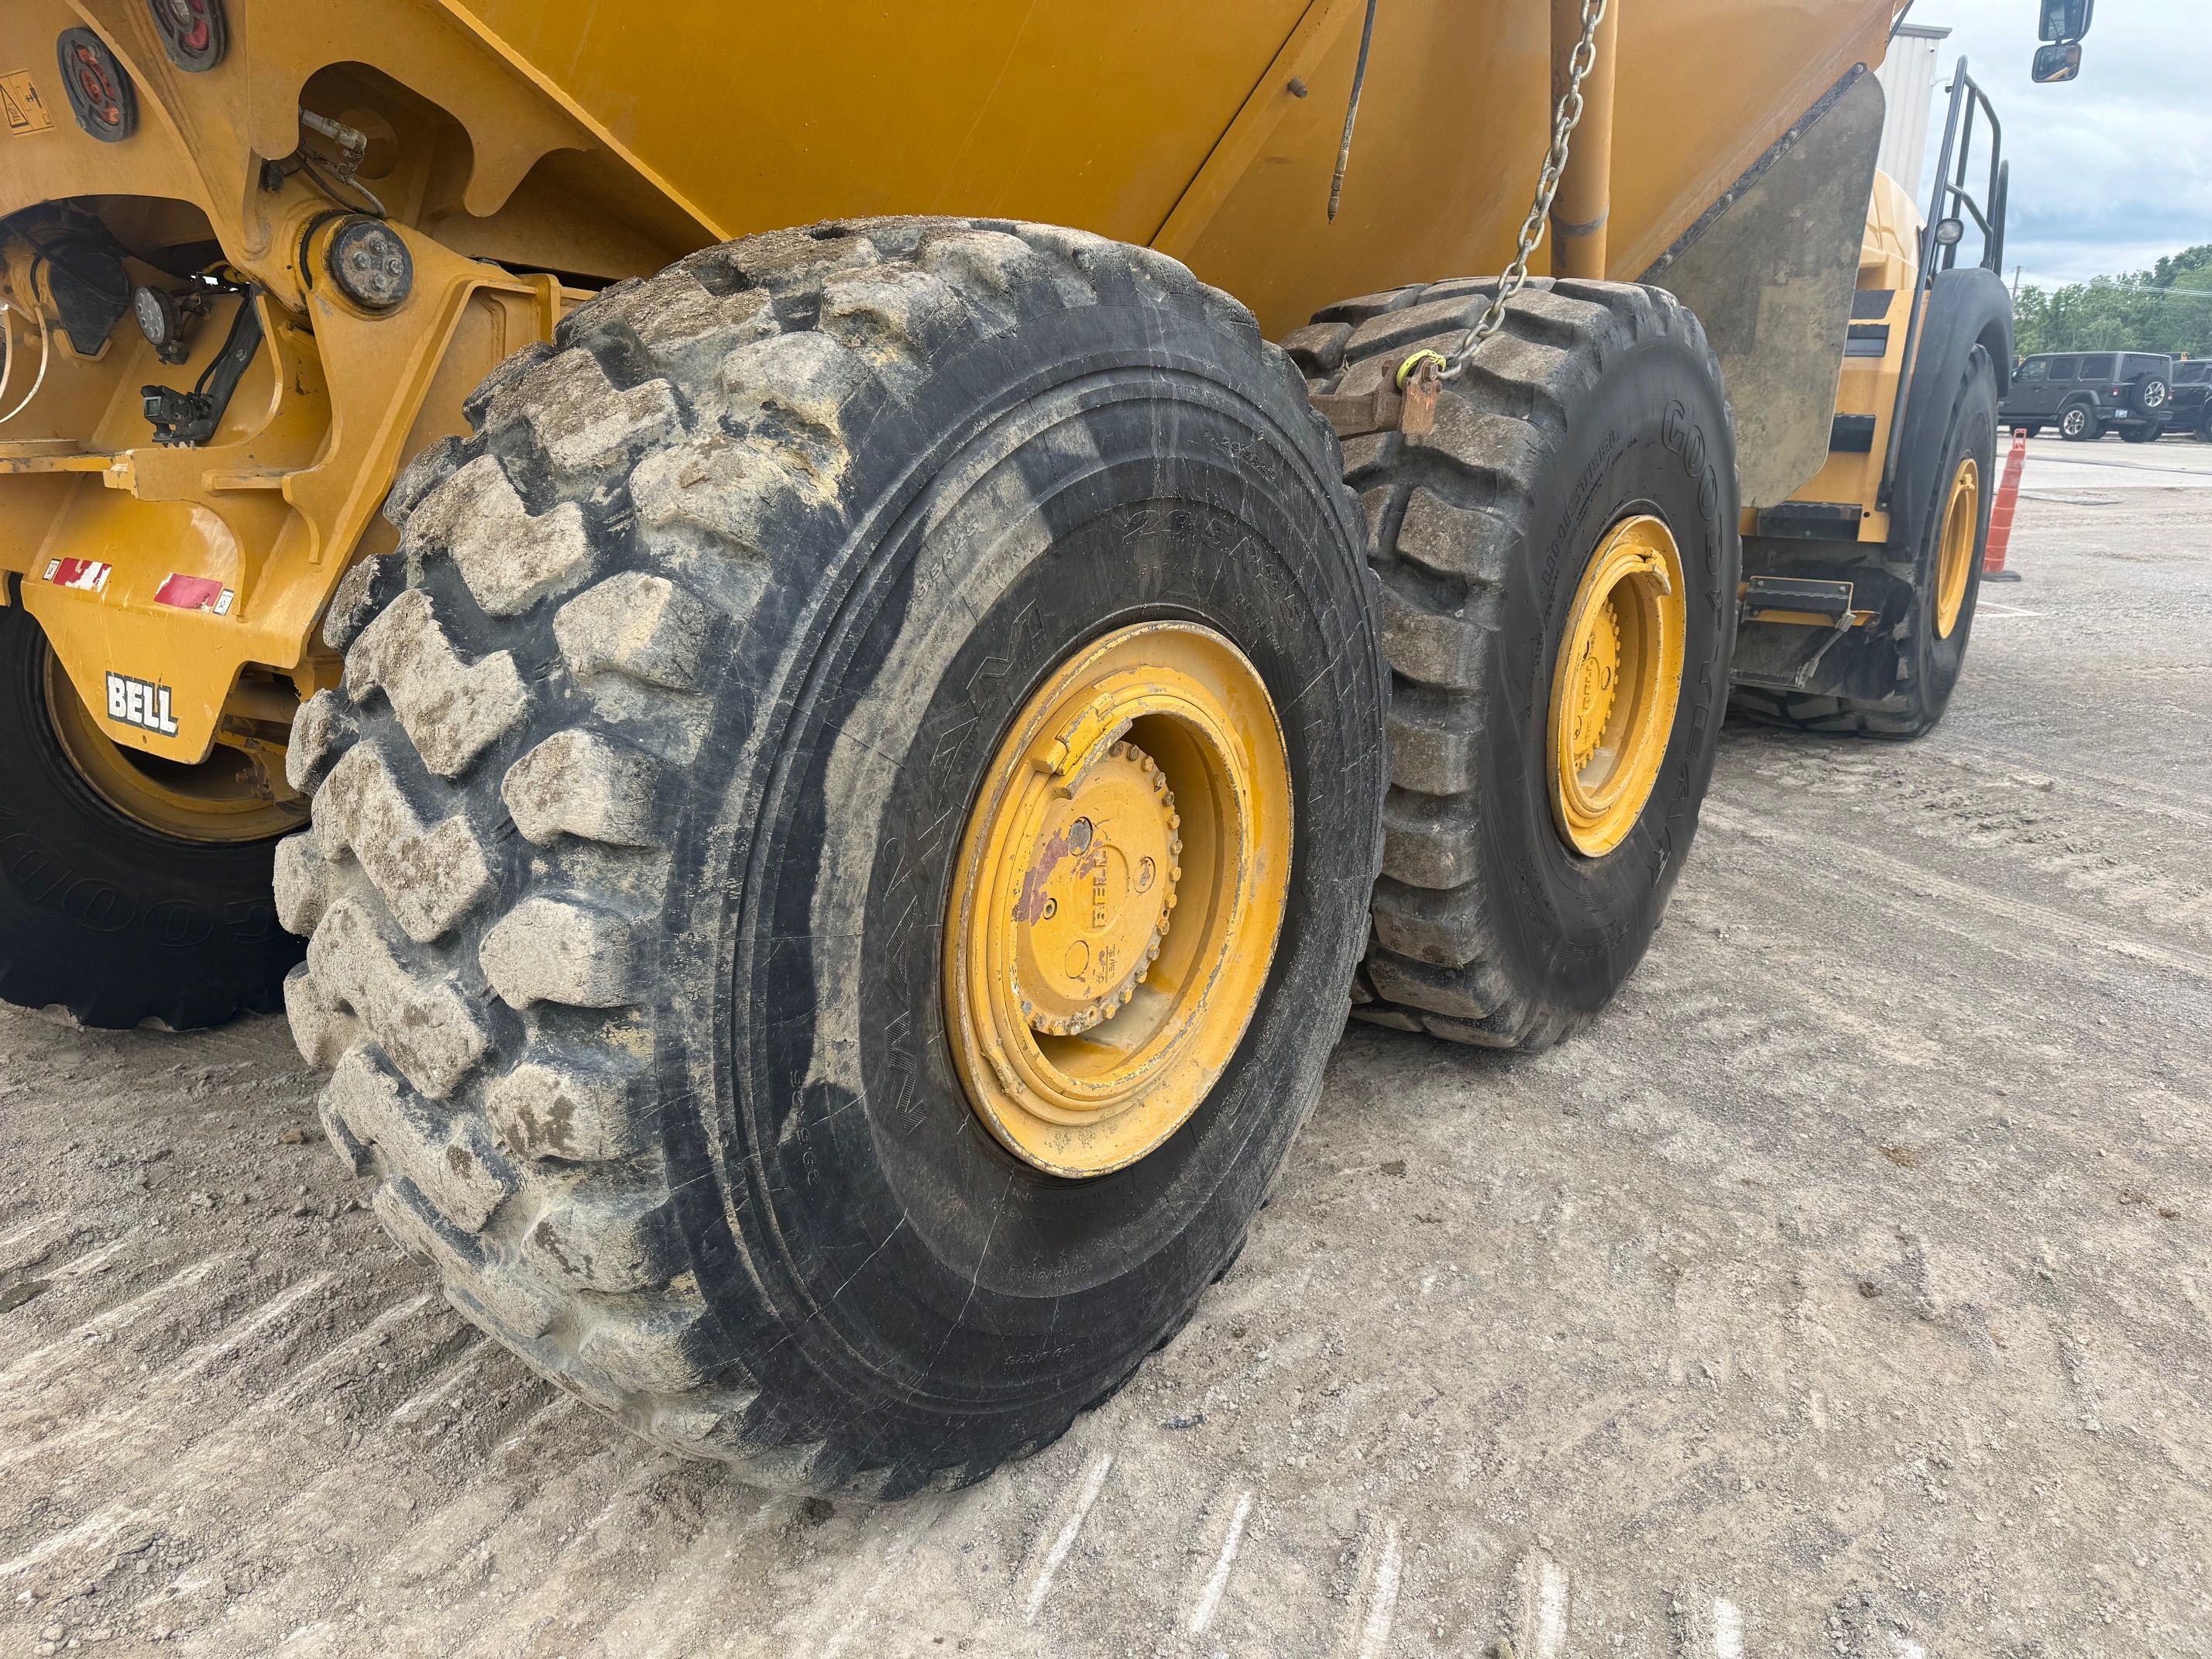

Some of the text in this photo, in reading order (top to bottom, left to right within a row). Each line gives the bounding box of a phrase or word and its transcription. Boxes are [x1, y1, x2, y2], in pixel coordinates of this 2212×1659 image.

[1647, 397, 1724, 888] GOODYEAR
[107, 674, 177, 735] BELL
[1582, 660, 1594, 709] BELL
[884, 598, 1044, 1135] MAXAM
[1093, 850, 1108, 928] BELL
